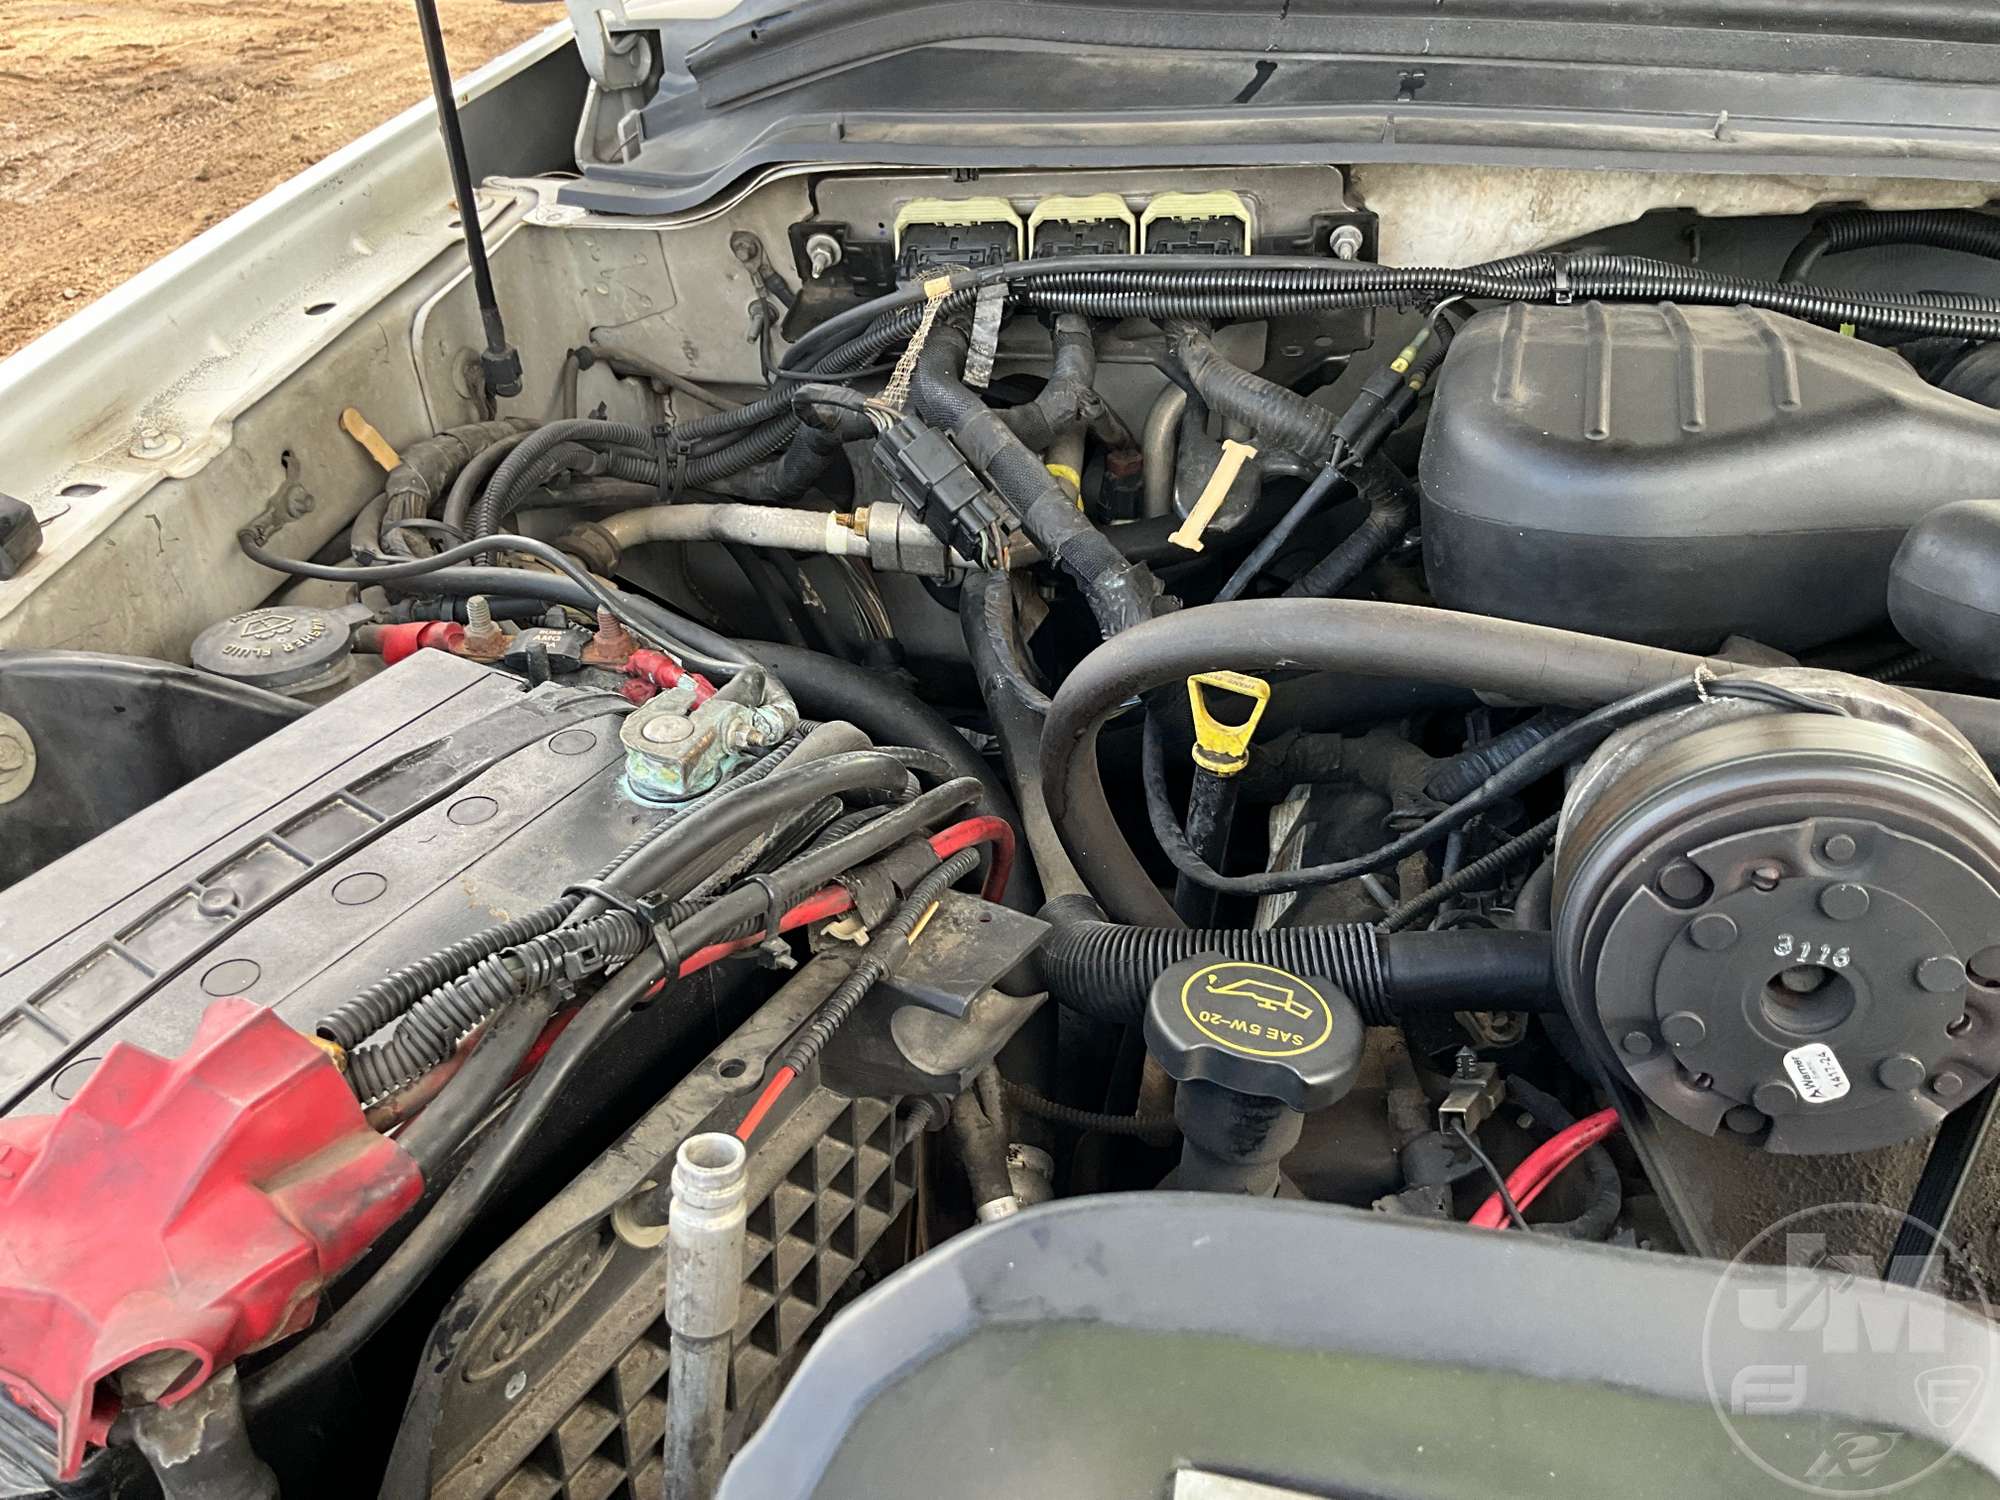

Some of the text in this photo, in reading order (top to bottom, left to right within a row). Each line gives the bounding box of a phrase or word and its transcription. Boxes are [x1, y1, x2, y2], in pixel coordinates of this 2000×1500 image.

[221, 642, 272, 659] FLUID
[1199, 1010, 1304, 1046] SAE 5W-20
[1791, 1056, 1817, 1090] Warner
